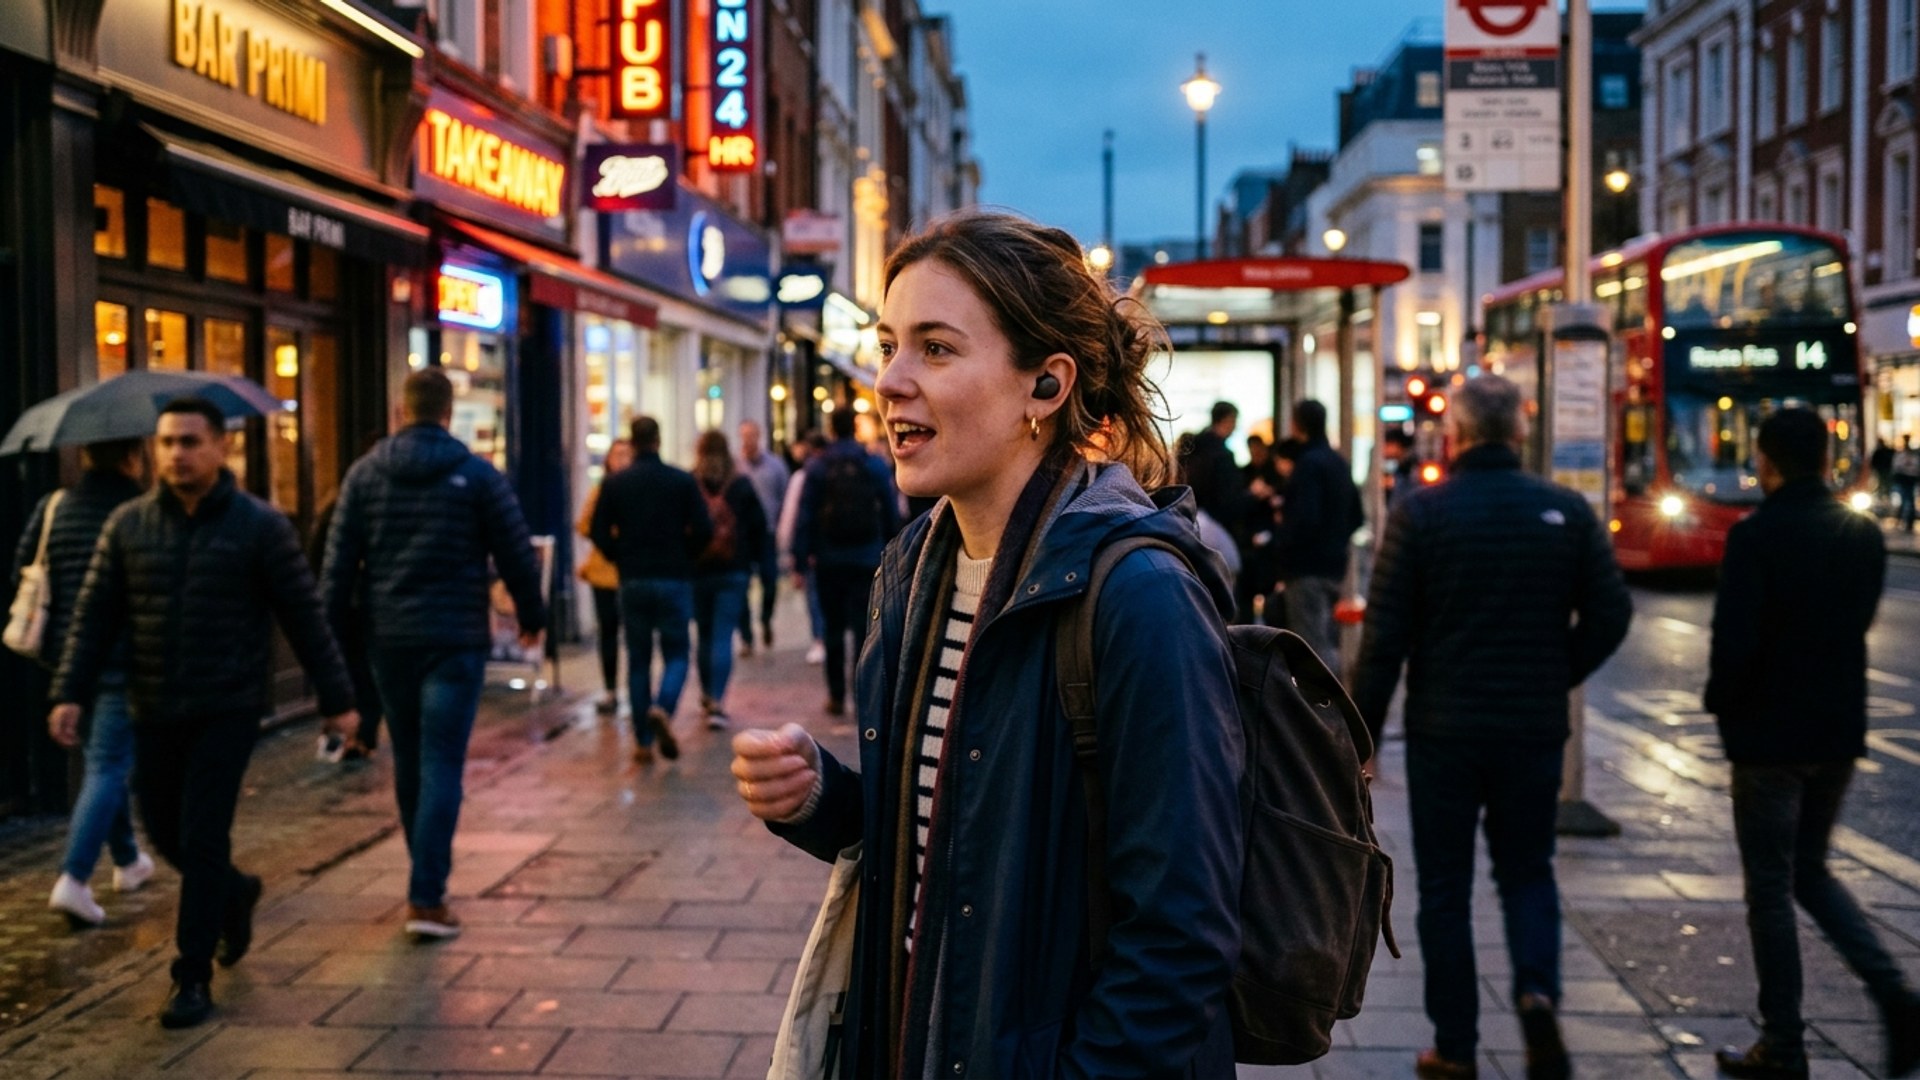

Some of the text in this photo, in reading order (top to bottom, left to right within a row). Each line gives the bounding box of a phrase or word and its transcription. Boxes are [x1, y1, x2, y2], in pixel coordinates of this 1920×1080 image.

[175, 0, 327, 126] BAR PRIMI
[426, 108, 565, 218] TAKEAWAY
[709, 135, 755, 166] HR
[1796, 340, 1827, 370] 14
